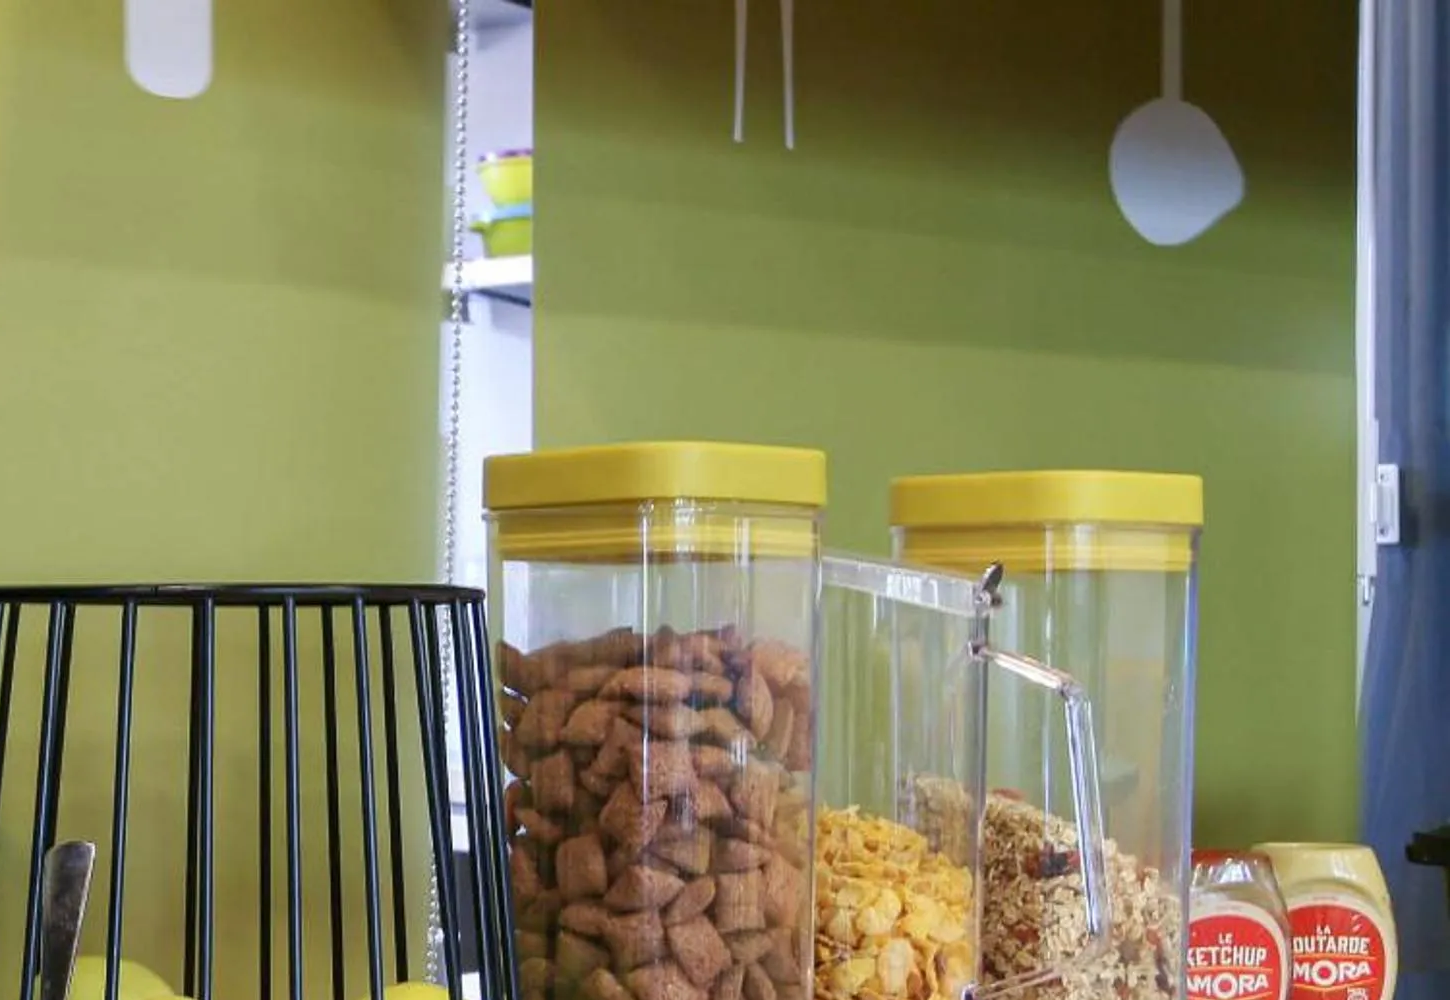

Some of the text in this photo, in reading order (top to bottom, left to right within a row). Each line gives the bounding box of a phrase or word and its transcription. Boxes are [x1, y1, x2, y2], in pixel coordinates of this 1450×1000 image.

[1316, 923, 1331, 935] LA
[1218, 932, 1233, 944] LE
[1292, 935, 1371, 955] OUTARDE
[1292, 959, 1372, 987] MORA
